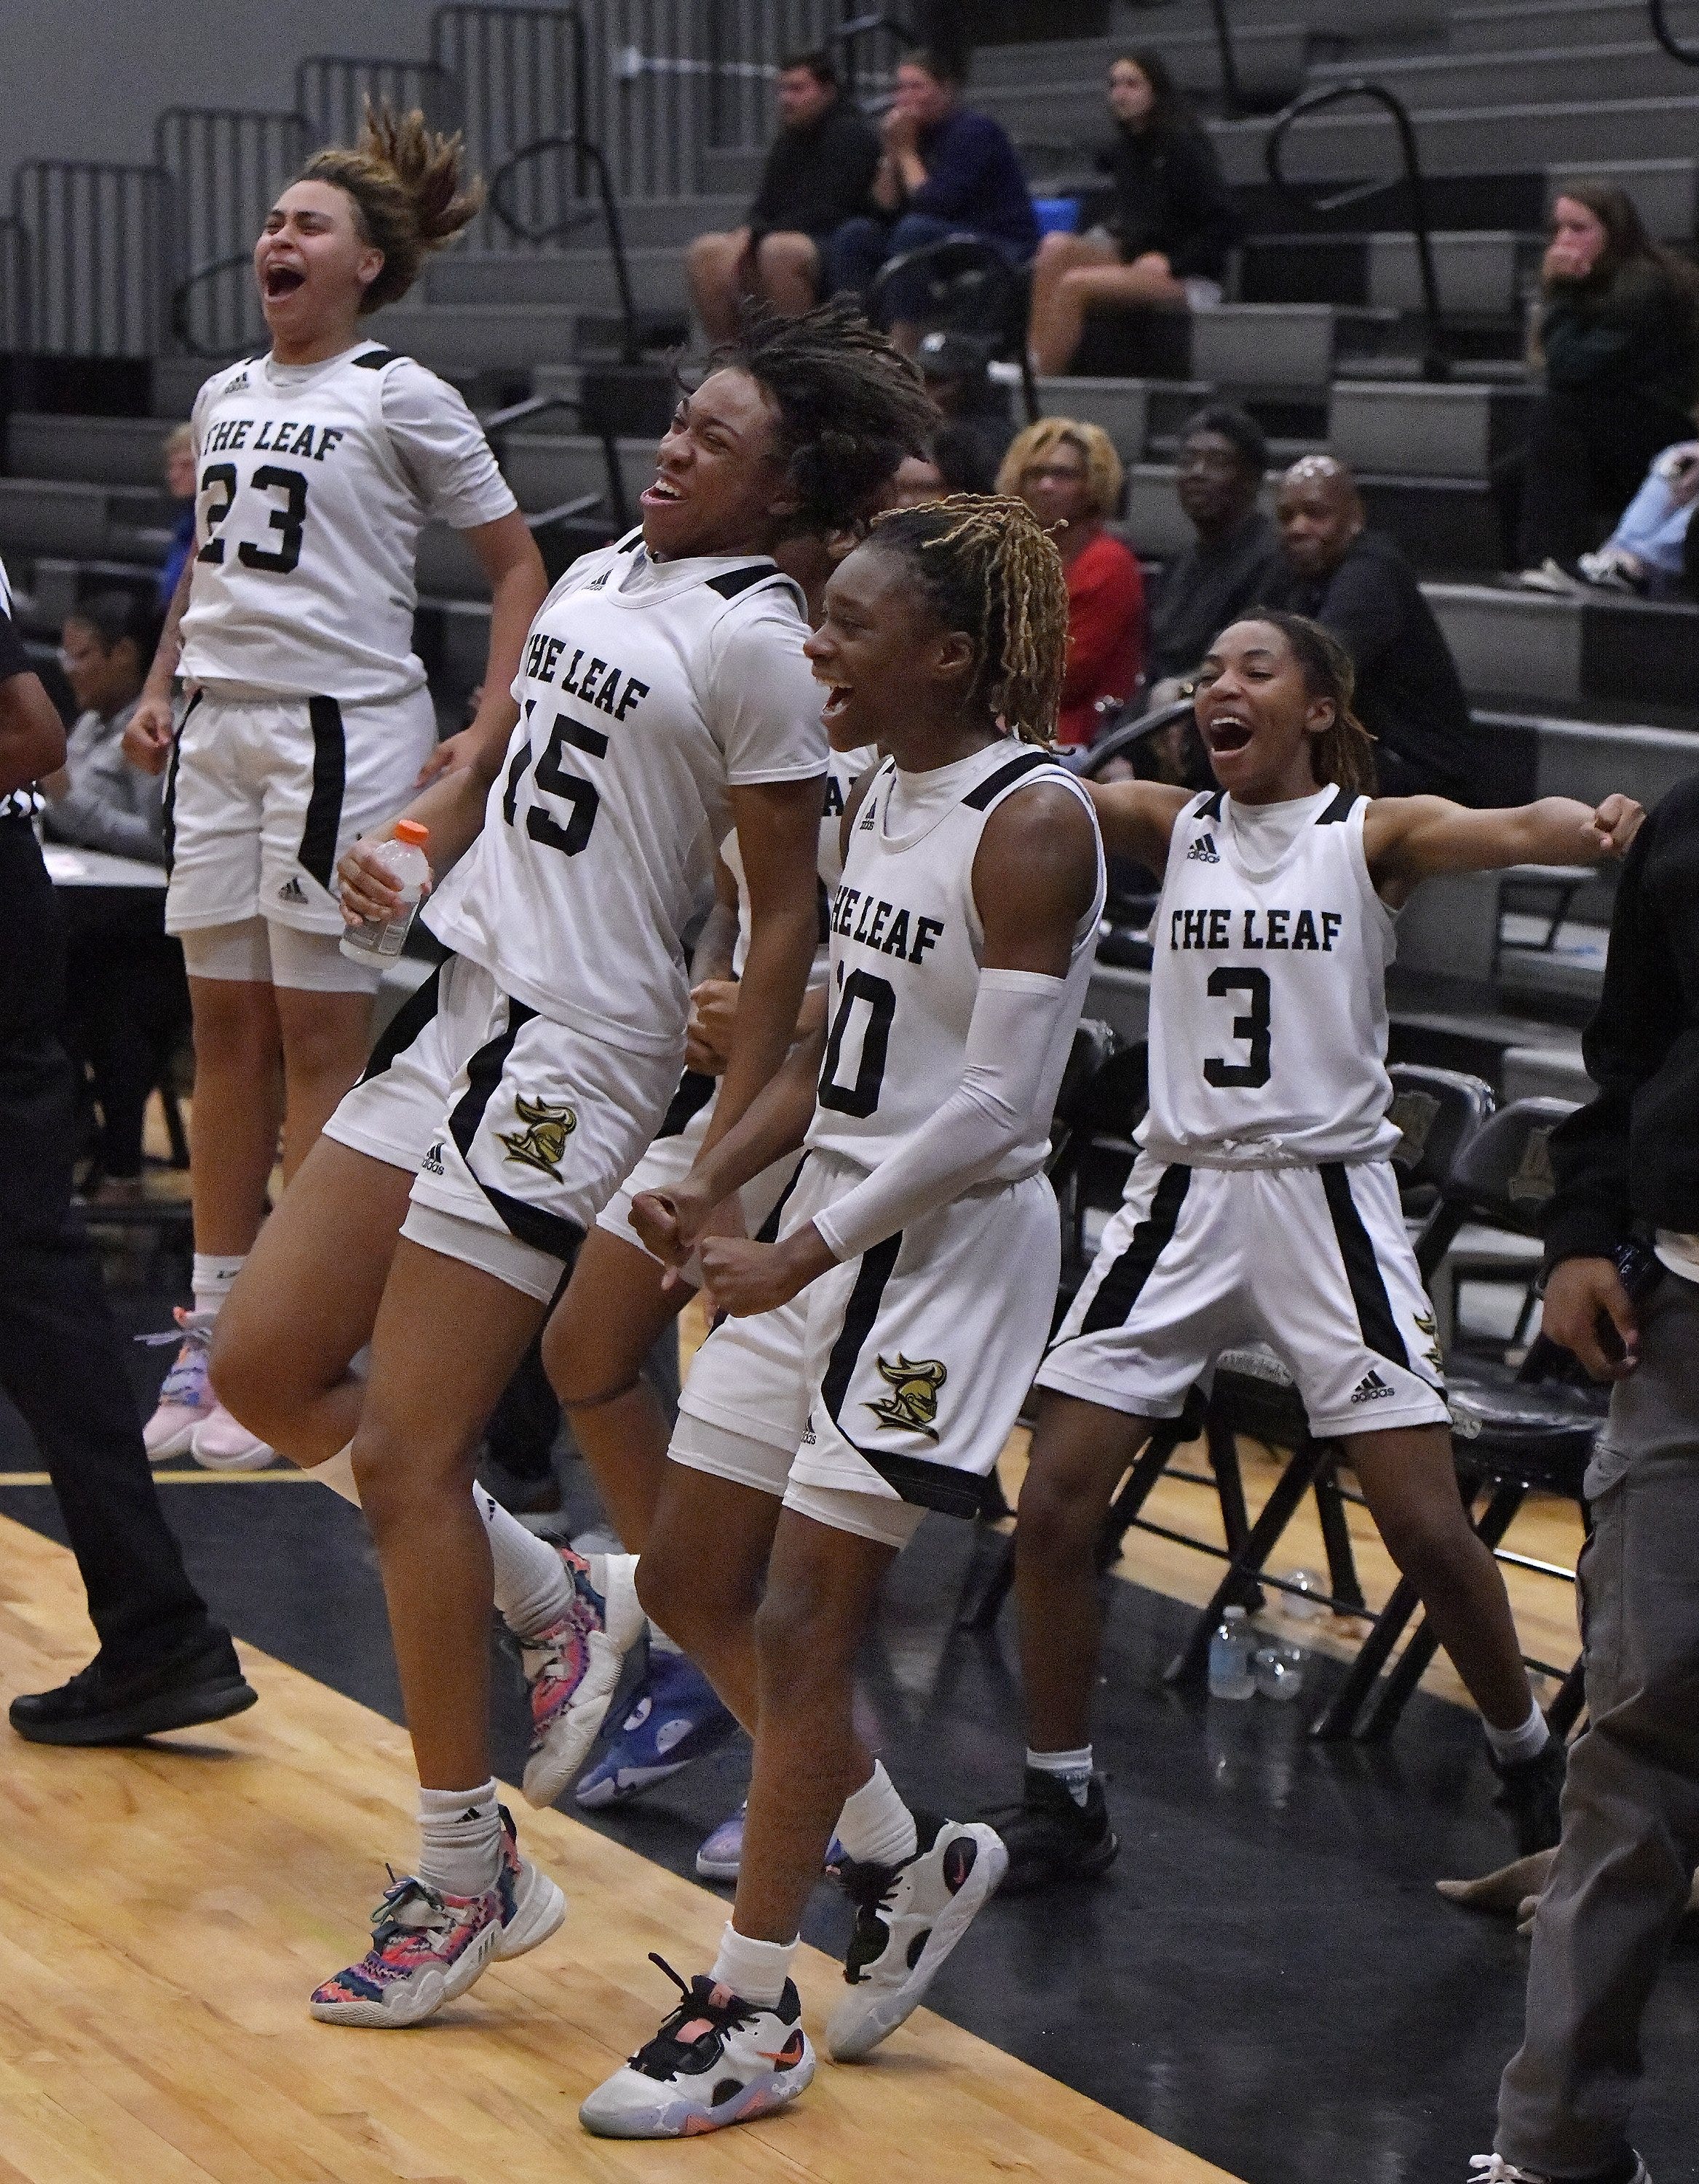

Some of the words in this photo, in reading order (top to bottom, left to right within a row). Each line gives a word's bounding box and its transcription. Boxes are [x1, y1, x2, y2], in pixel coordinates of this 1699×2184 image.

[253, 422, 343, 462] LEAF
[197, 463, 308, 574] 23
[561, 649, 650, 721] LEAF
[831, 885, 862, 937] HE
[853, 895, 945, 965] LEAF
[1171, 909, 1232, 950] THE
[1243, 909, 1342, 951] LEAF
[818, 960, 896, 1120] 0
[1203, 967, 1271, 1088] 3
